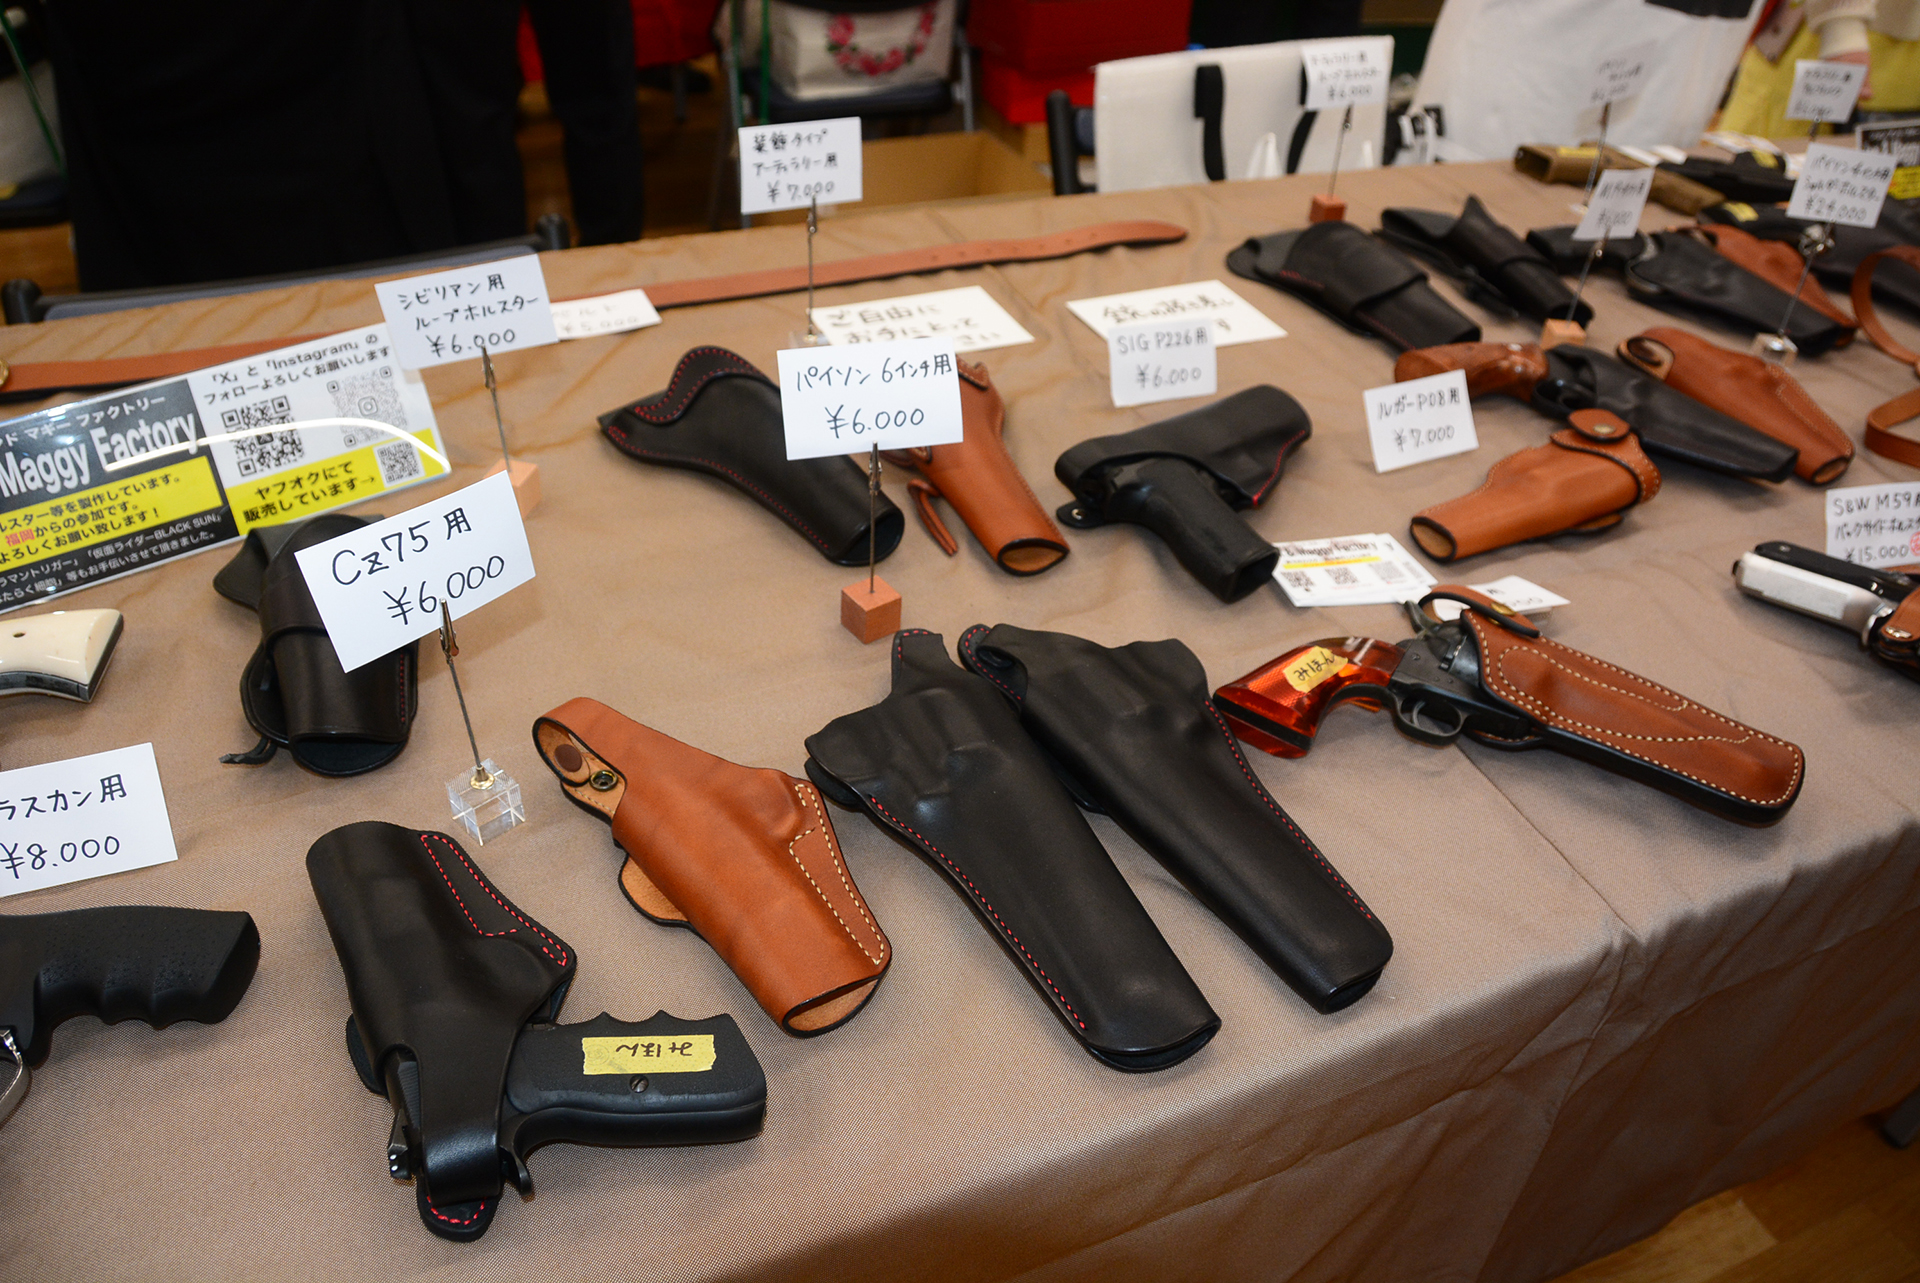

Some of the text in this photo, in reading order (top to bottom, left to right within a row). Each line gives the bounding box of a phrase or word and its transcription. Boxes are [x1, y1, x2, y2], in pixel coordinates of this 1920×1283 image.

[753, 128, 828, 153] 装飾タイプ
[415, 295, 539, 331] ループホルスター
[826, 305, 940, 328] ご自由に
[247, 365, 259, 377] と
[365, 333, 378, 345] の
[1117, 326, 1208, 354] SIG P226用
[204, 345, 390, 405] フォローよろしくお願いします
[797, 353, 952, 392] パイソン 6インチ用
[24, 420, 71, 441] マギー
[76, 396, 166, 427] ファクトリー
[0, 413, 198, 498] Maggy Factory
[254, 461, 354, 500] ヤフオクにて
[5, 503, 139, 546] 福岡からの参加です。
[1833, 497, 1871, 517] S&W
[0, 774, 127, 820] ラスカン用
[615, 1041, 693, 1058] みほん
